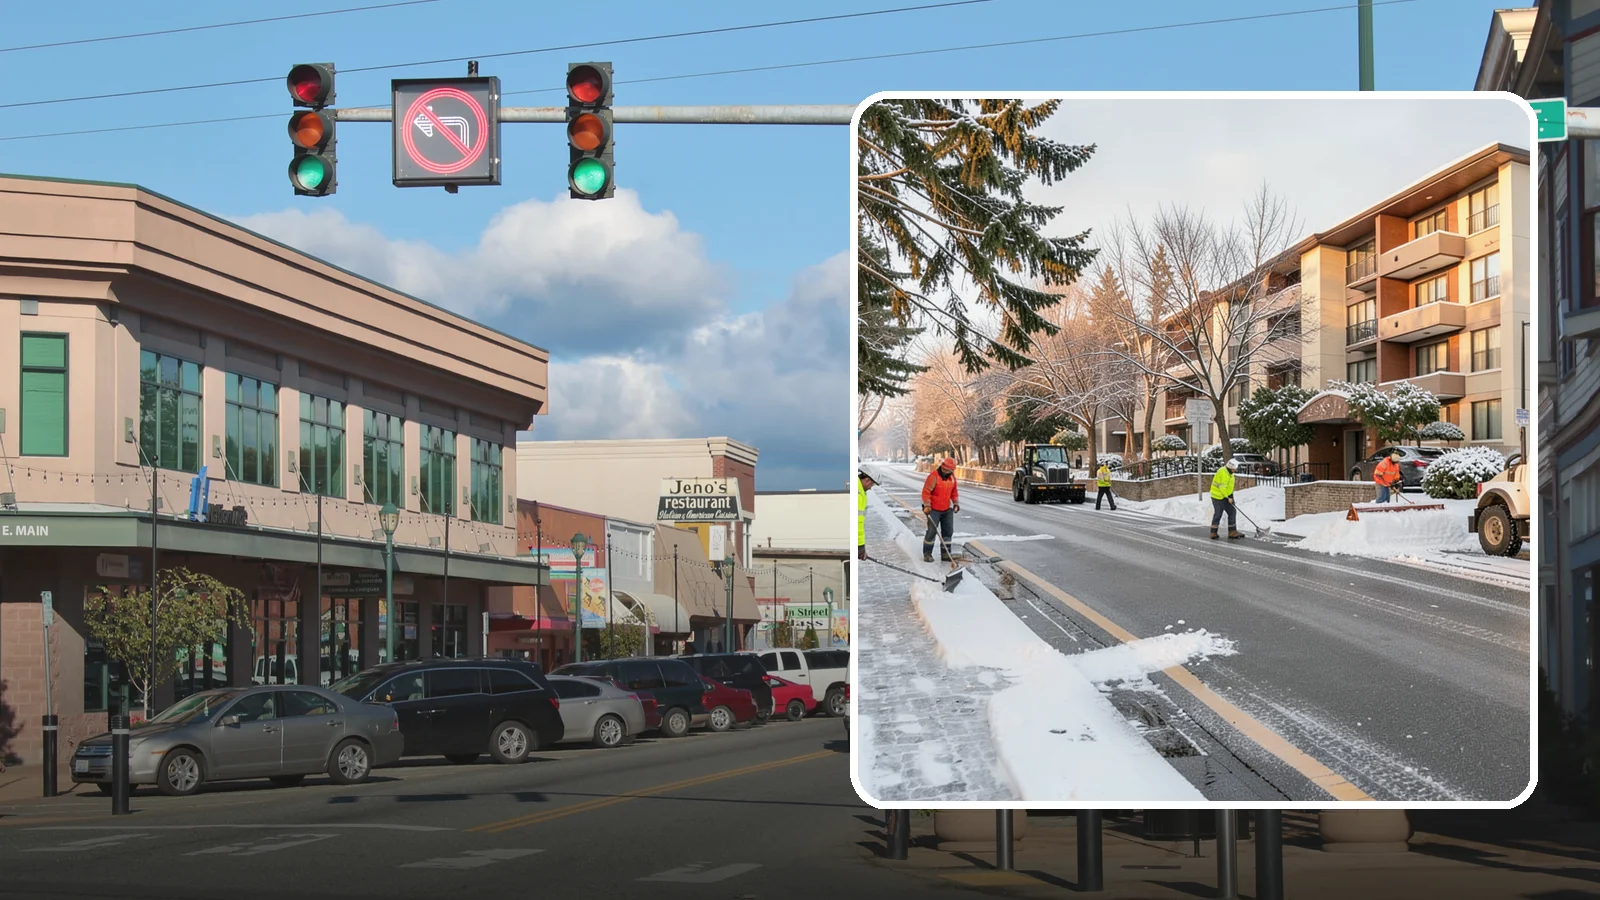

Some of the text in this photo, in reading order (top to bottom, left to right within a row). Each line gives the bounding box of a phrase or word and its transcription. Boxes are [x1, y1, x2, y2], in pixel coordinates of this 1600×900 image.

[669, 480, 728, 494] Jeno's
[665, 496, 731, 509] restaurant
[686, 510, 714, 519] American
[715, 510, 737, 519] Cuisine
[2, 525, 49, 536] E. MAIN
[797, 608, 828, 616] Street
